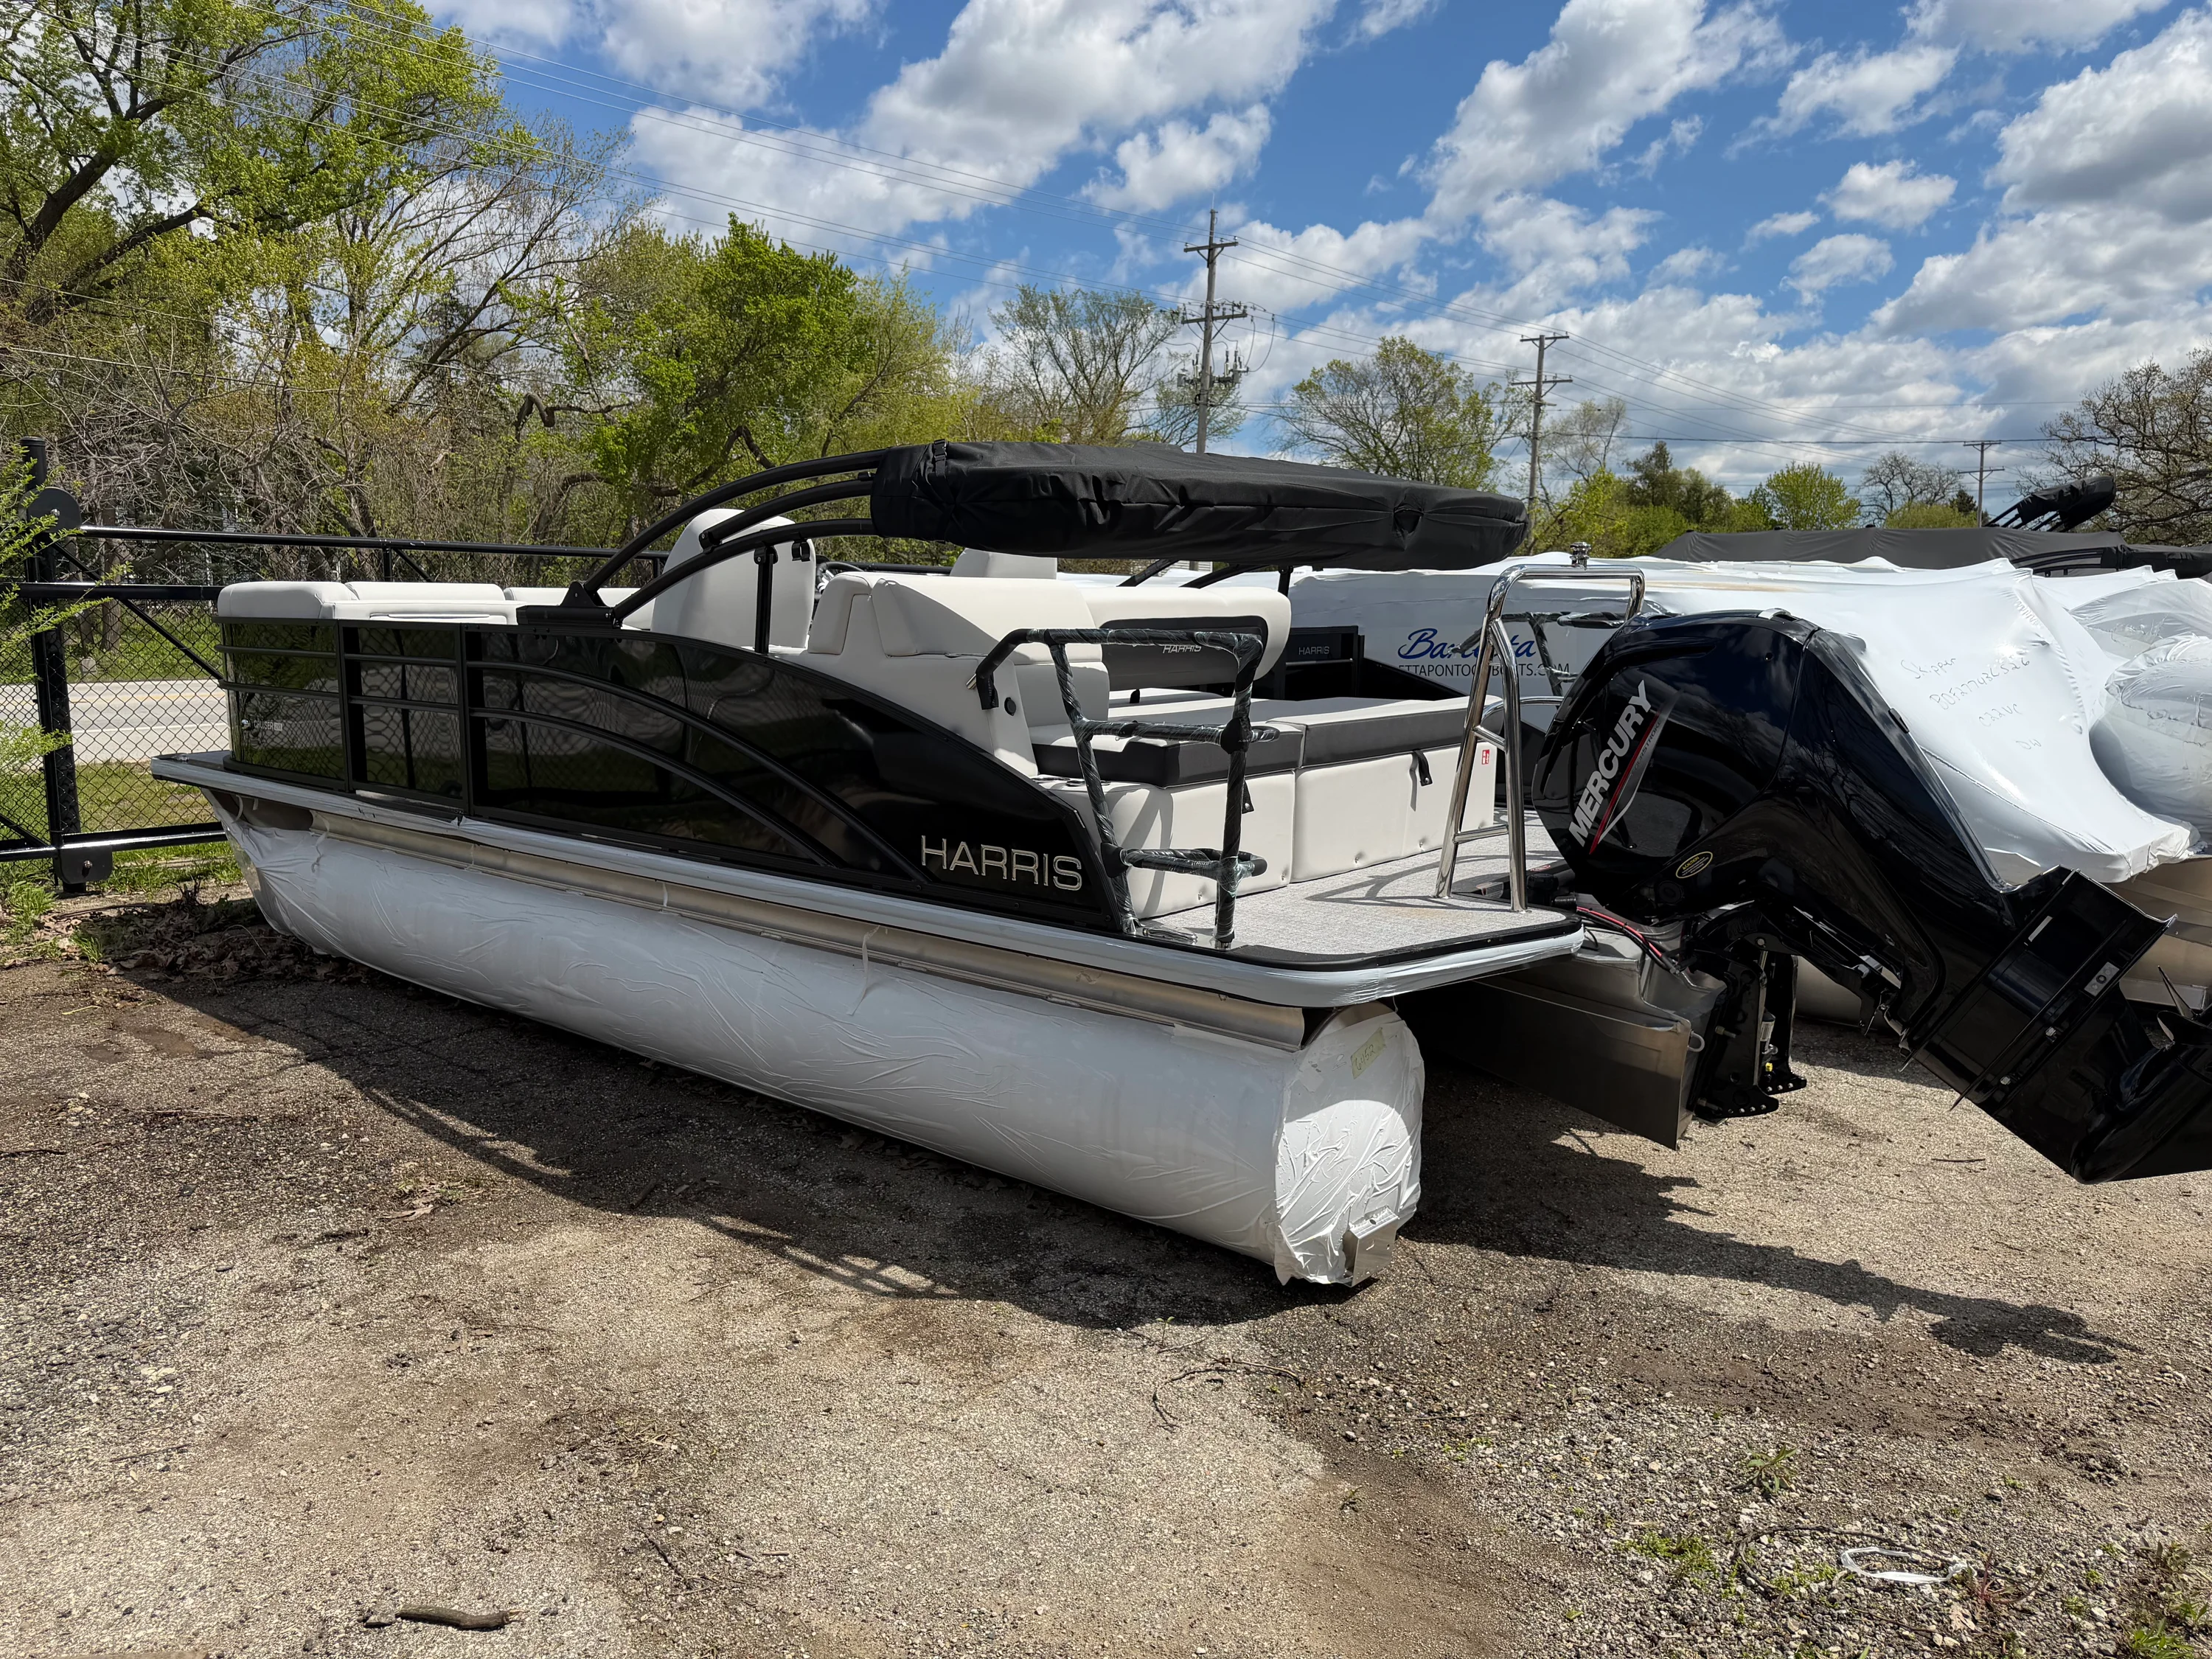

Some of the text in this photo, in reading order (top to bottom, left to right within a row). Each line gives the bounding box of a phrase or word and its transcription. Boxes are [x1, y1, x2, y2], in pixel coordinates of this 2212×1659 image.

[1298, 646, 1330, 655] HARRIS
[1398, 627, 1536, 660] Bata
[1568, 679, 1652, 847] MERCURY
[921, 835, 1082, 891] HARRIS
